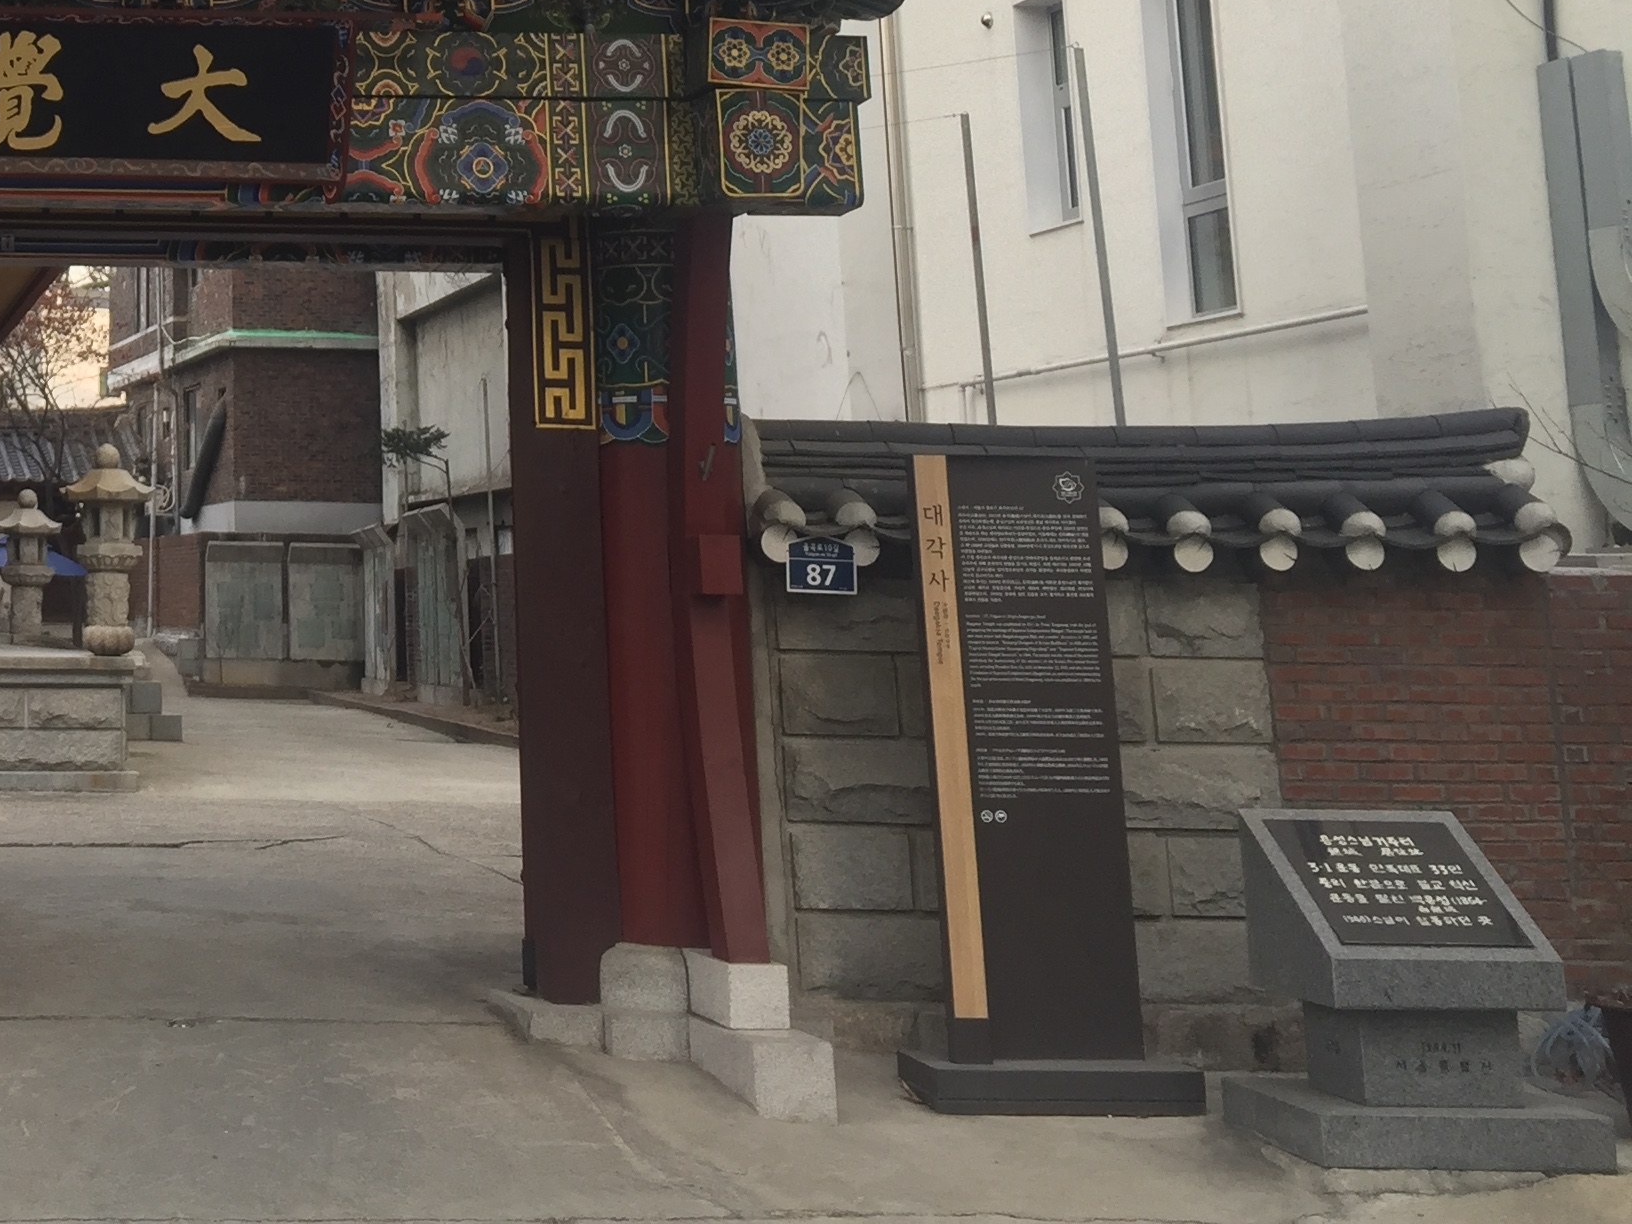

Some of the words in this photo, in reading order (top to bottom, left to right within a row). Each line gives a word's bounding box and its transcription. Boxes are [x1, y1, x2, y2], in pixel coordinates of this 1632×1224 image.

[923, 504, 950, 593] 대각사
[806, 563, 837, 586] 87
[1428, 864, 1463, 875] 33인
[1416, 879, 1446, 890] 불교
